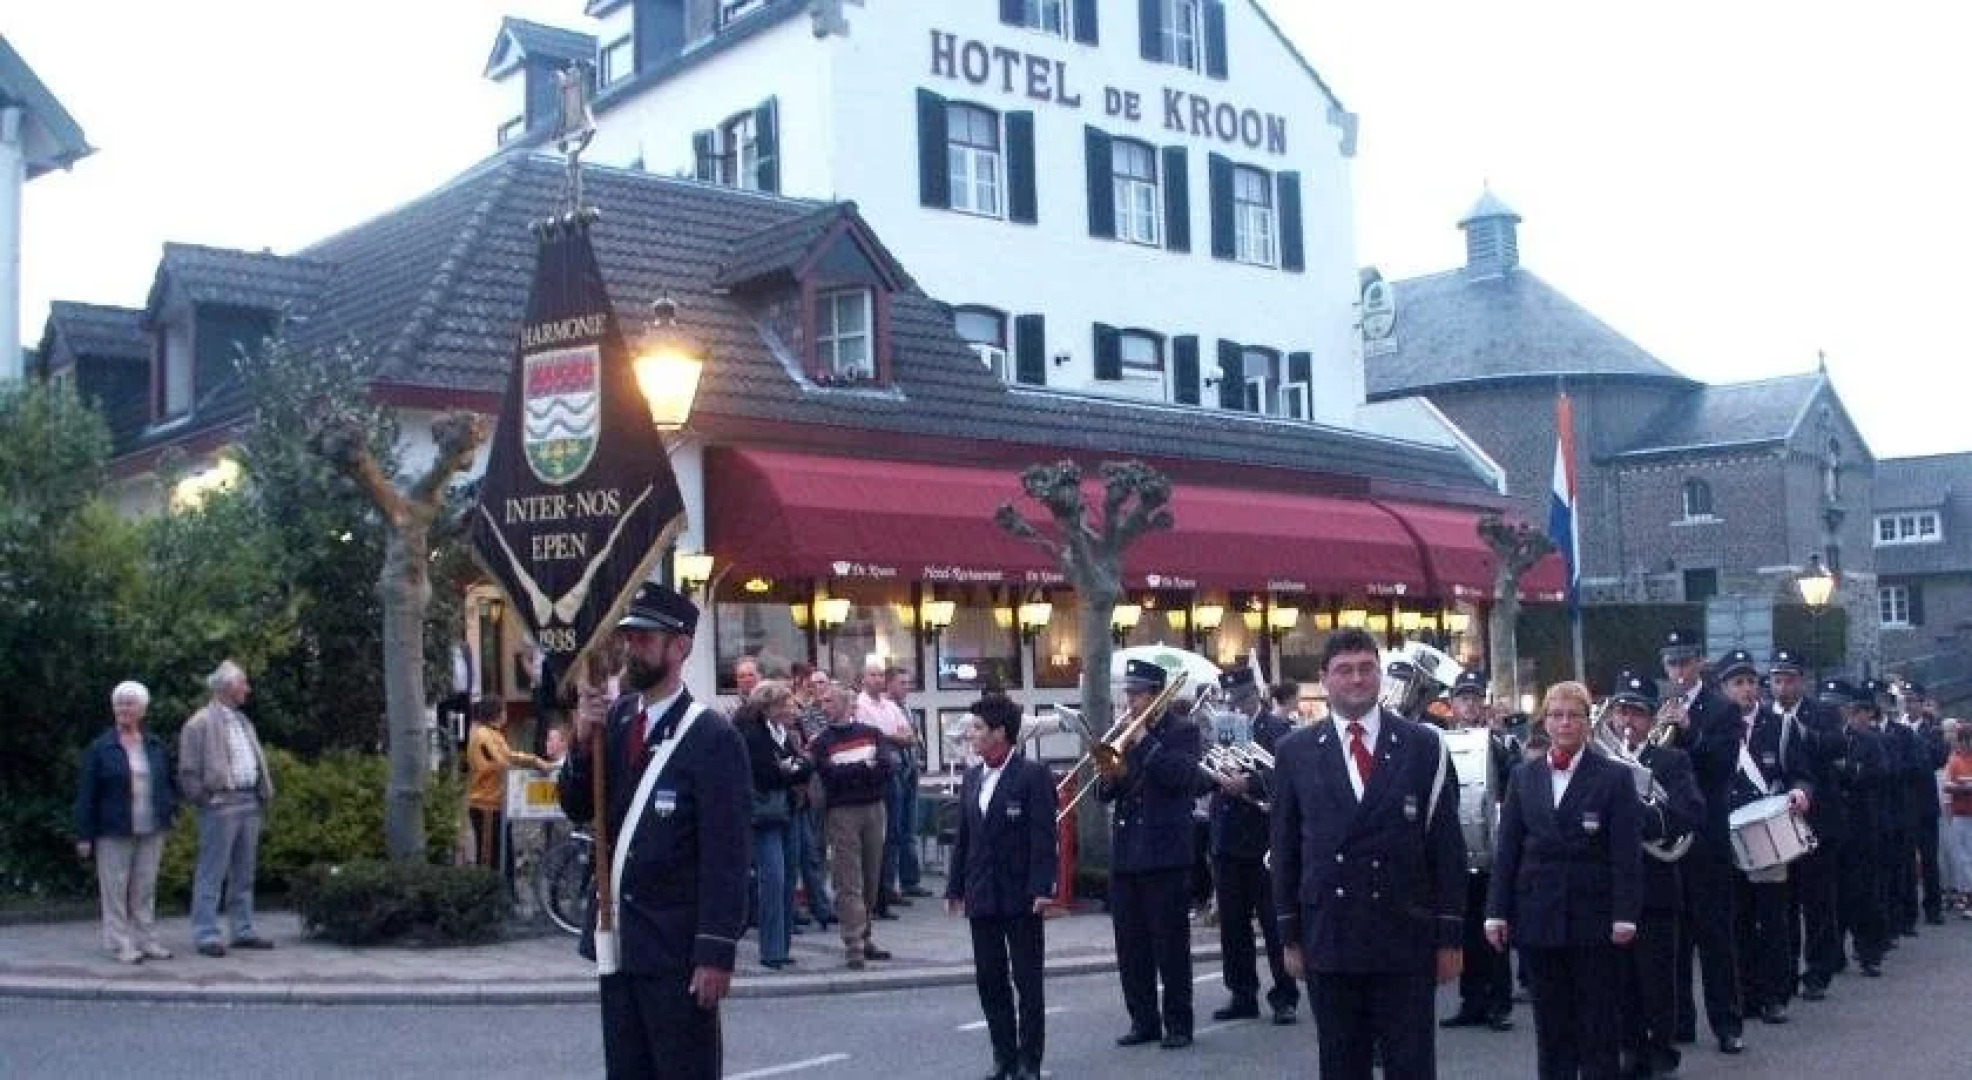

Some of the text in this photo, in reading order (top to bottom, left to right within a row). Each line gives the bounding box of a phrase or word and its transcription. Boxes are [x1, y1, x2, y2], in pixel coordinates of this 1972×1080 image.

[930, 29, 1288, 156] HOTEL DE KROON
[505, 489, 621, 524] INTER-NOS
[531, 534, 587, 560] EPEN
